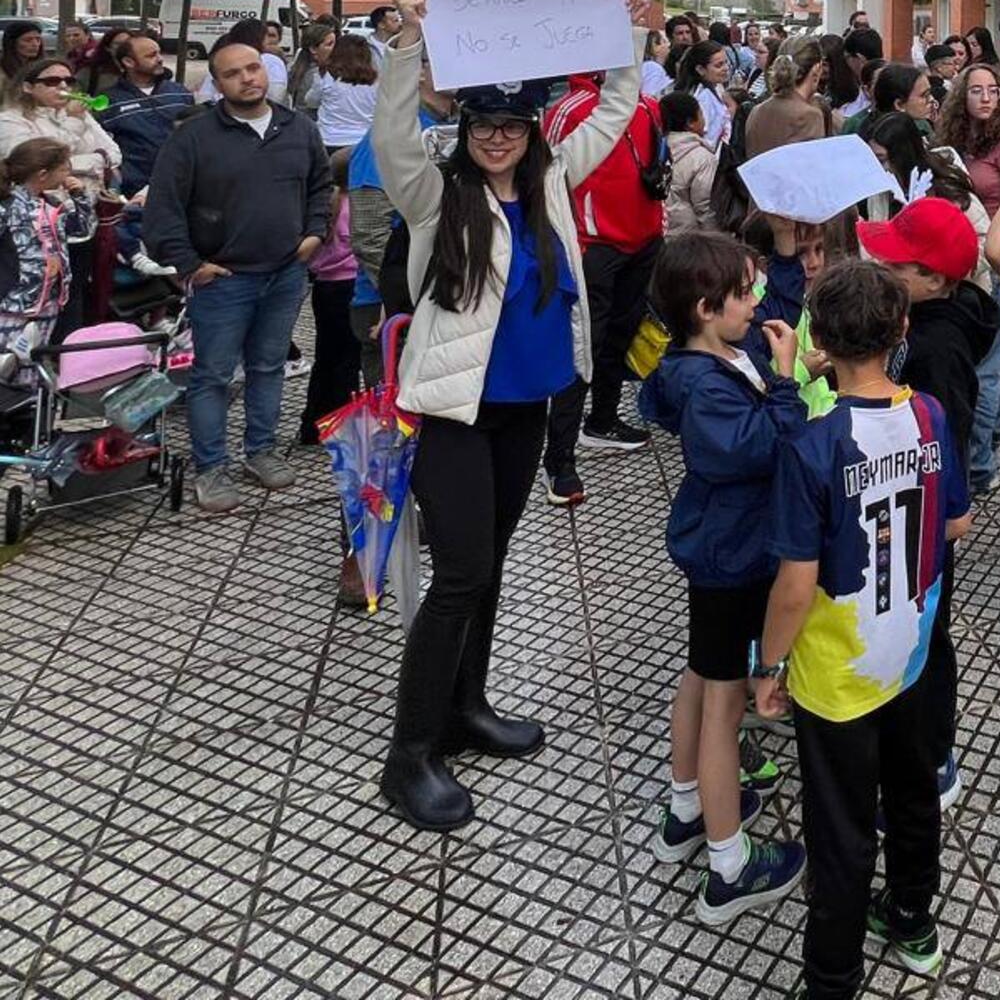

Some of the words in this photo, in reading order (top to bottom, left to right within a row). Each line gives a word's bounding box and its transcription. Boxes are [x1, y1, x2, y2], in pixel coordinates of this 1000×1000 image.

[455, 31, 488, 55] NO
[844, 449, 919, 497] NEYMAR
[922, 441, 941, 473] JR
[864, 485, 925, 616] 11
